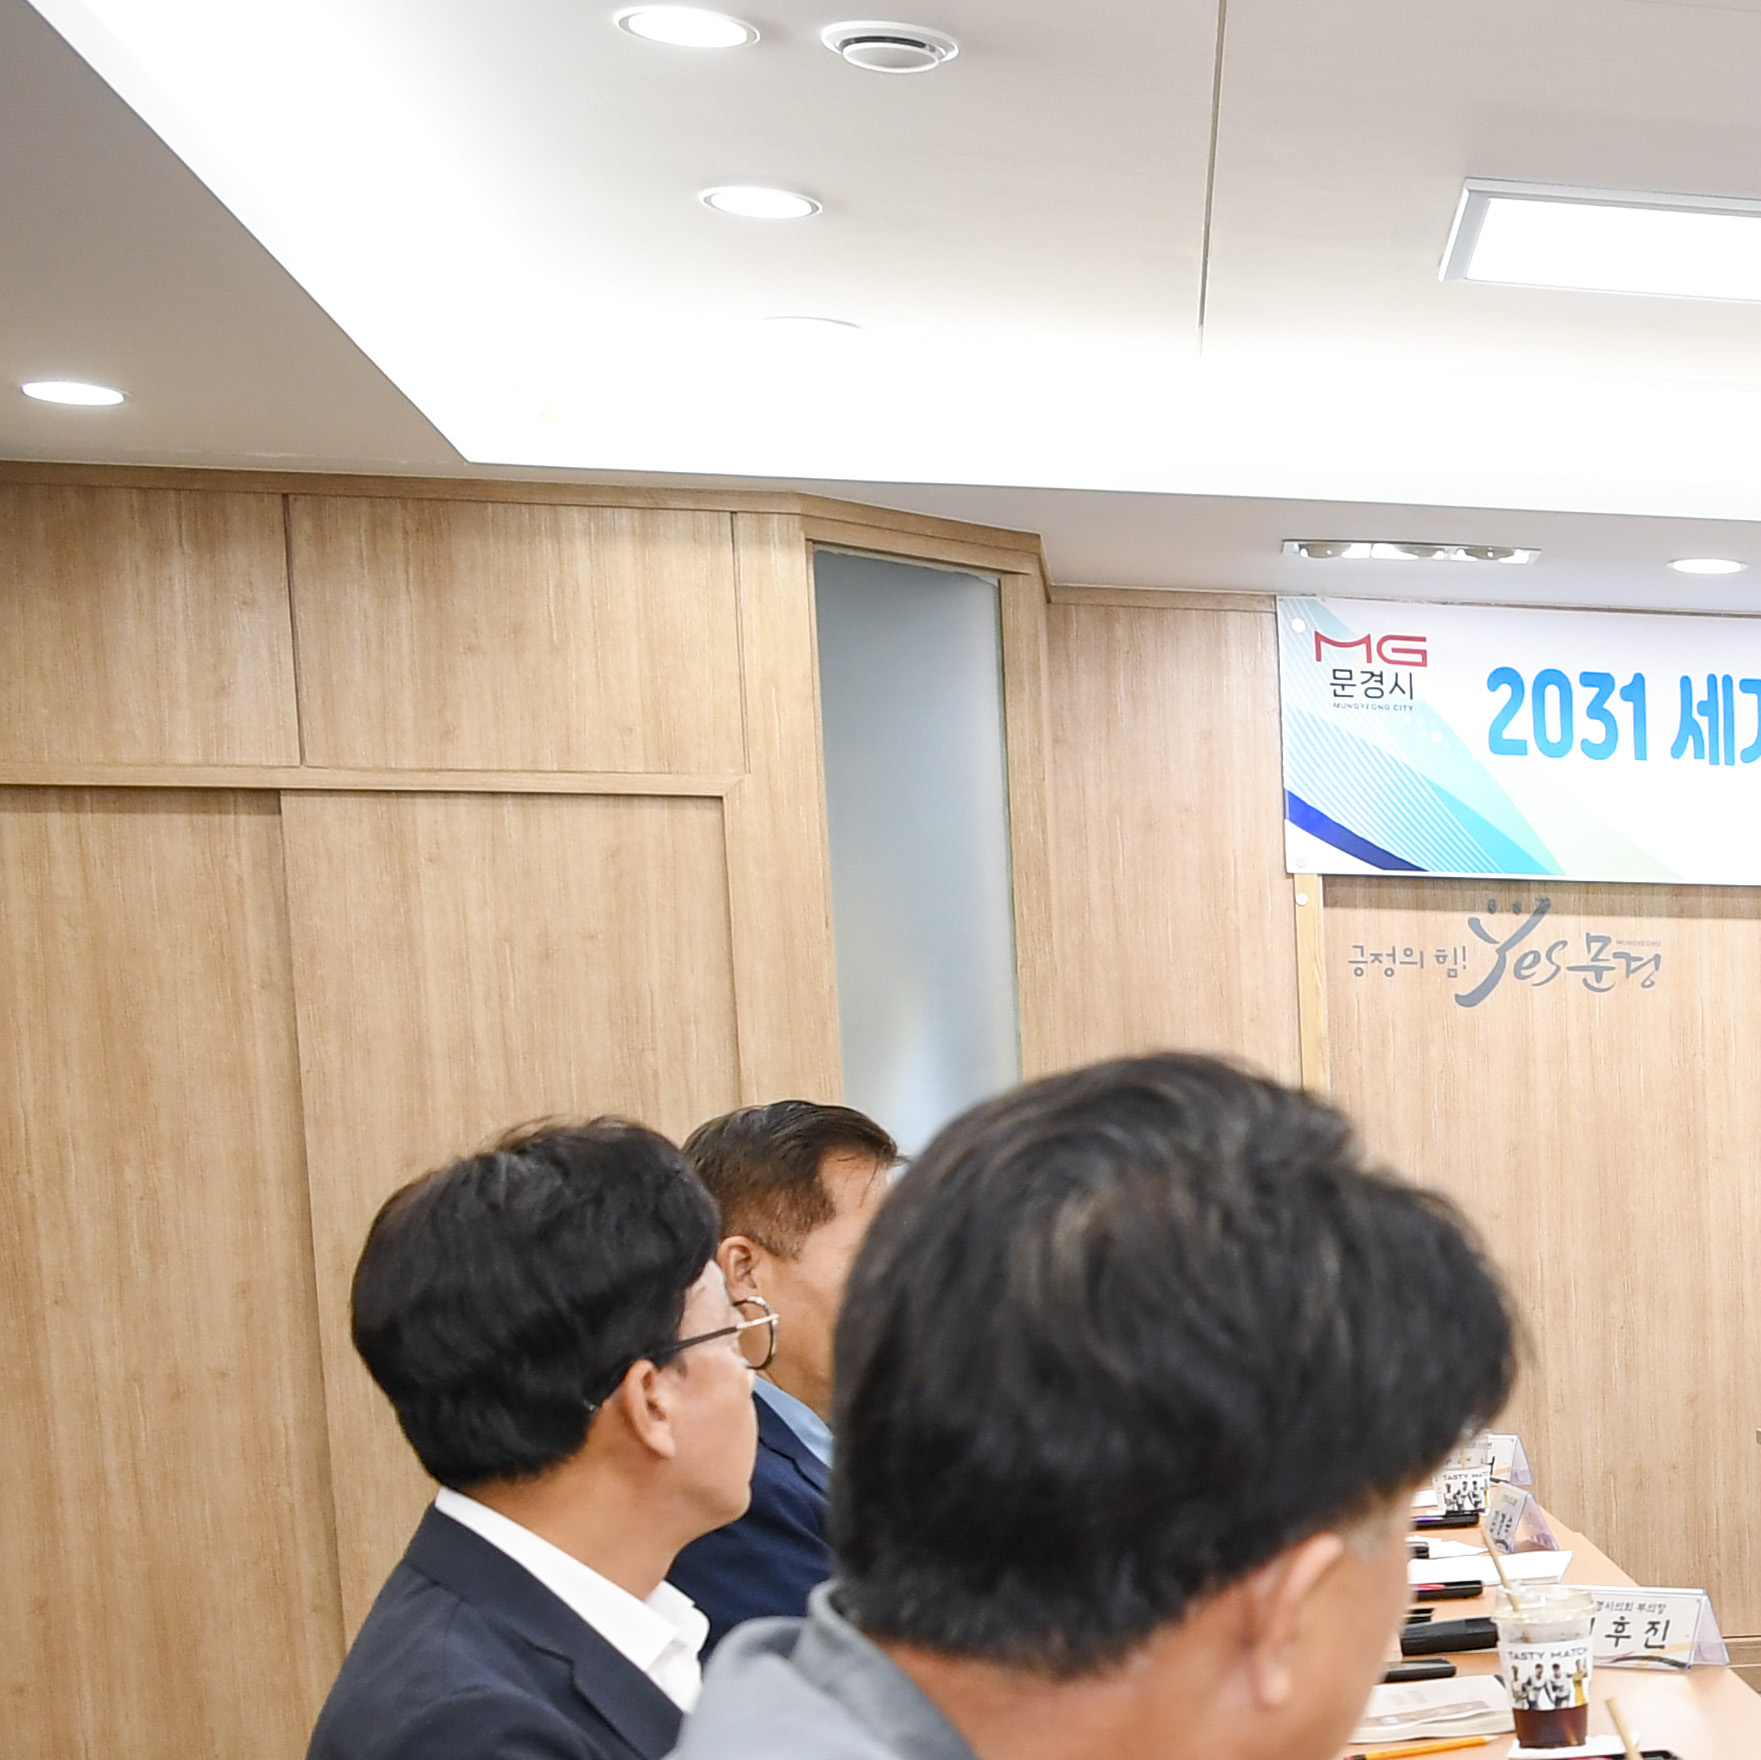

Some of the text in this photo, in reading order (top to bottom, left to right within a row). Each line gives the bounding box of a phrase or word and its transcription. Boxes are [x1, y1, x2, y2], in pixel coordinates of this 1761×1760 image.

[1314, 630, 1428, 668] MG
[1329, 668, 1414, 700] 문경시
[1393, 703, 1414, 712] CITY
[1486, 666, 1648, 761] 2031
[1348, 945, 1424, 978] 긍정의
[1454, 896, 1569, 1008] Yes
[1566, 932, 1662, 993] 문경
[1508, 1650, 1545, 1661] TASTY
